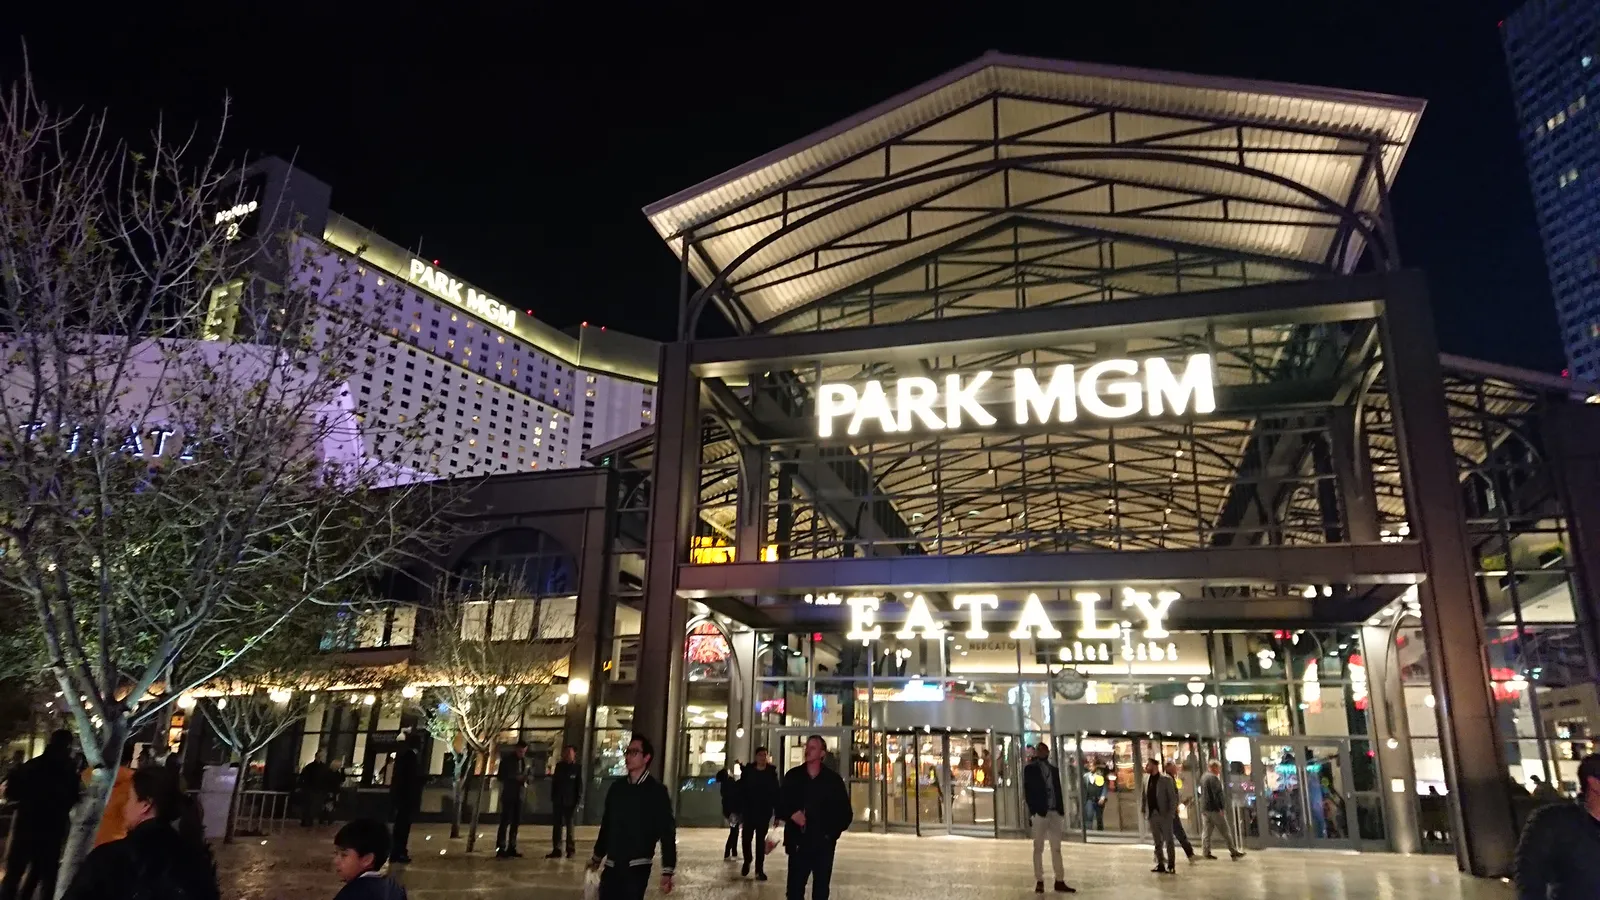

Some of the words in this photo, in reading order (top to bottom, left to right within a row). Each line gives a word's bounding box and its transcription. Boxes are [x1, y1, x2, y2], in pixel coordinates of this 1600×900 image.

[409, 258, 464, 303] PARK
[466, 288, 517, 331] MGM
[818, 371, 997, 438] PARK
[1013, 353, 1217, 425] MGM
[846, 591, 1181, 640] EATALY
